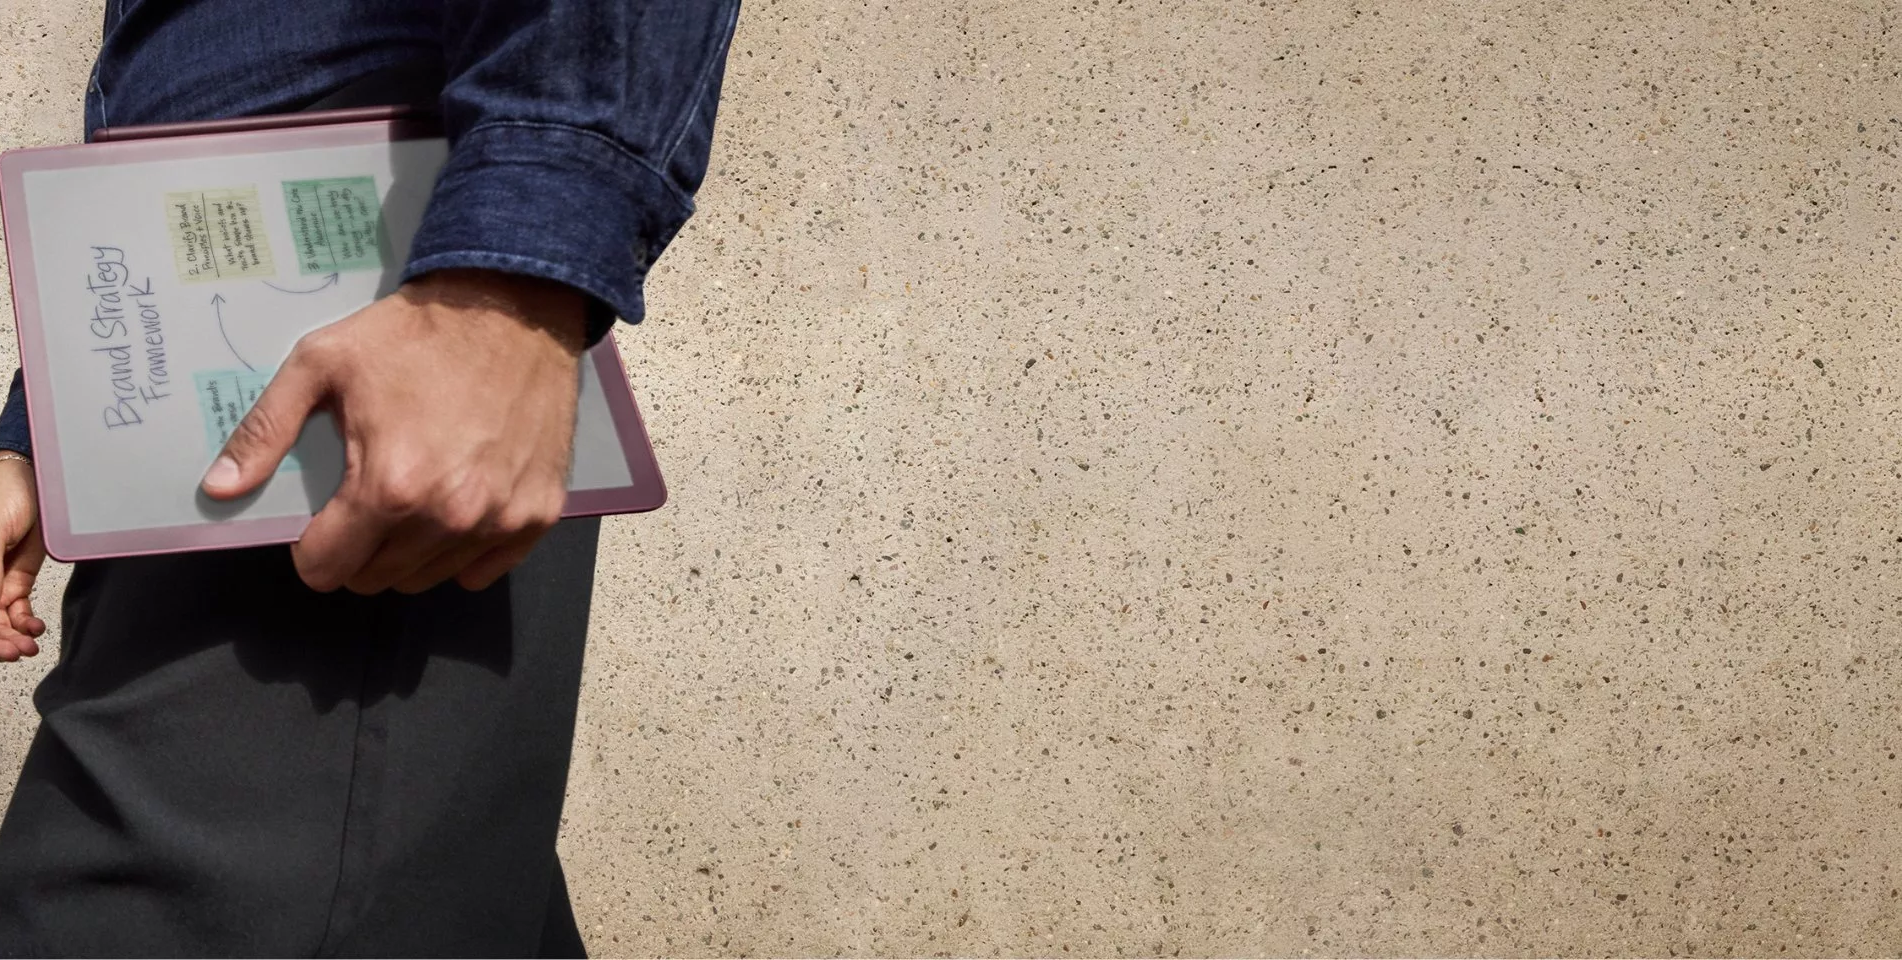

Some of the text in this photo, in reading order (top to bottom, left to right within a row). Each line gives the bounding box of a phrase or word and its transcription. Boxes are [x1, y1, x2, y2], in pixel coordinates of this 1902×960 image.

[193, 205, 202, 224] Voice
[212, 203, 224, 215] and
[175, 203, 199, 275] 2. Clarify Brand
[198, 234, 213, 270] Principles
[224, 244, 236, 265] What
[246, 245, 260, 266] brand
[296, 217, 315, 259] Understand
[86, 246, 143, 430] Brand Strategy
[127, 277, 173, 405] Framework
